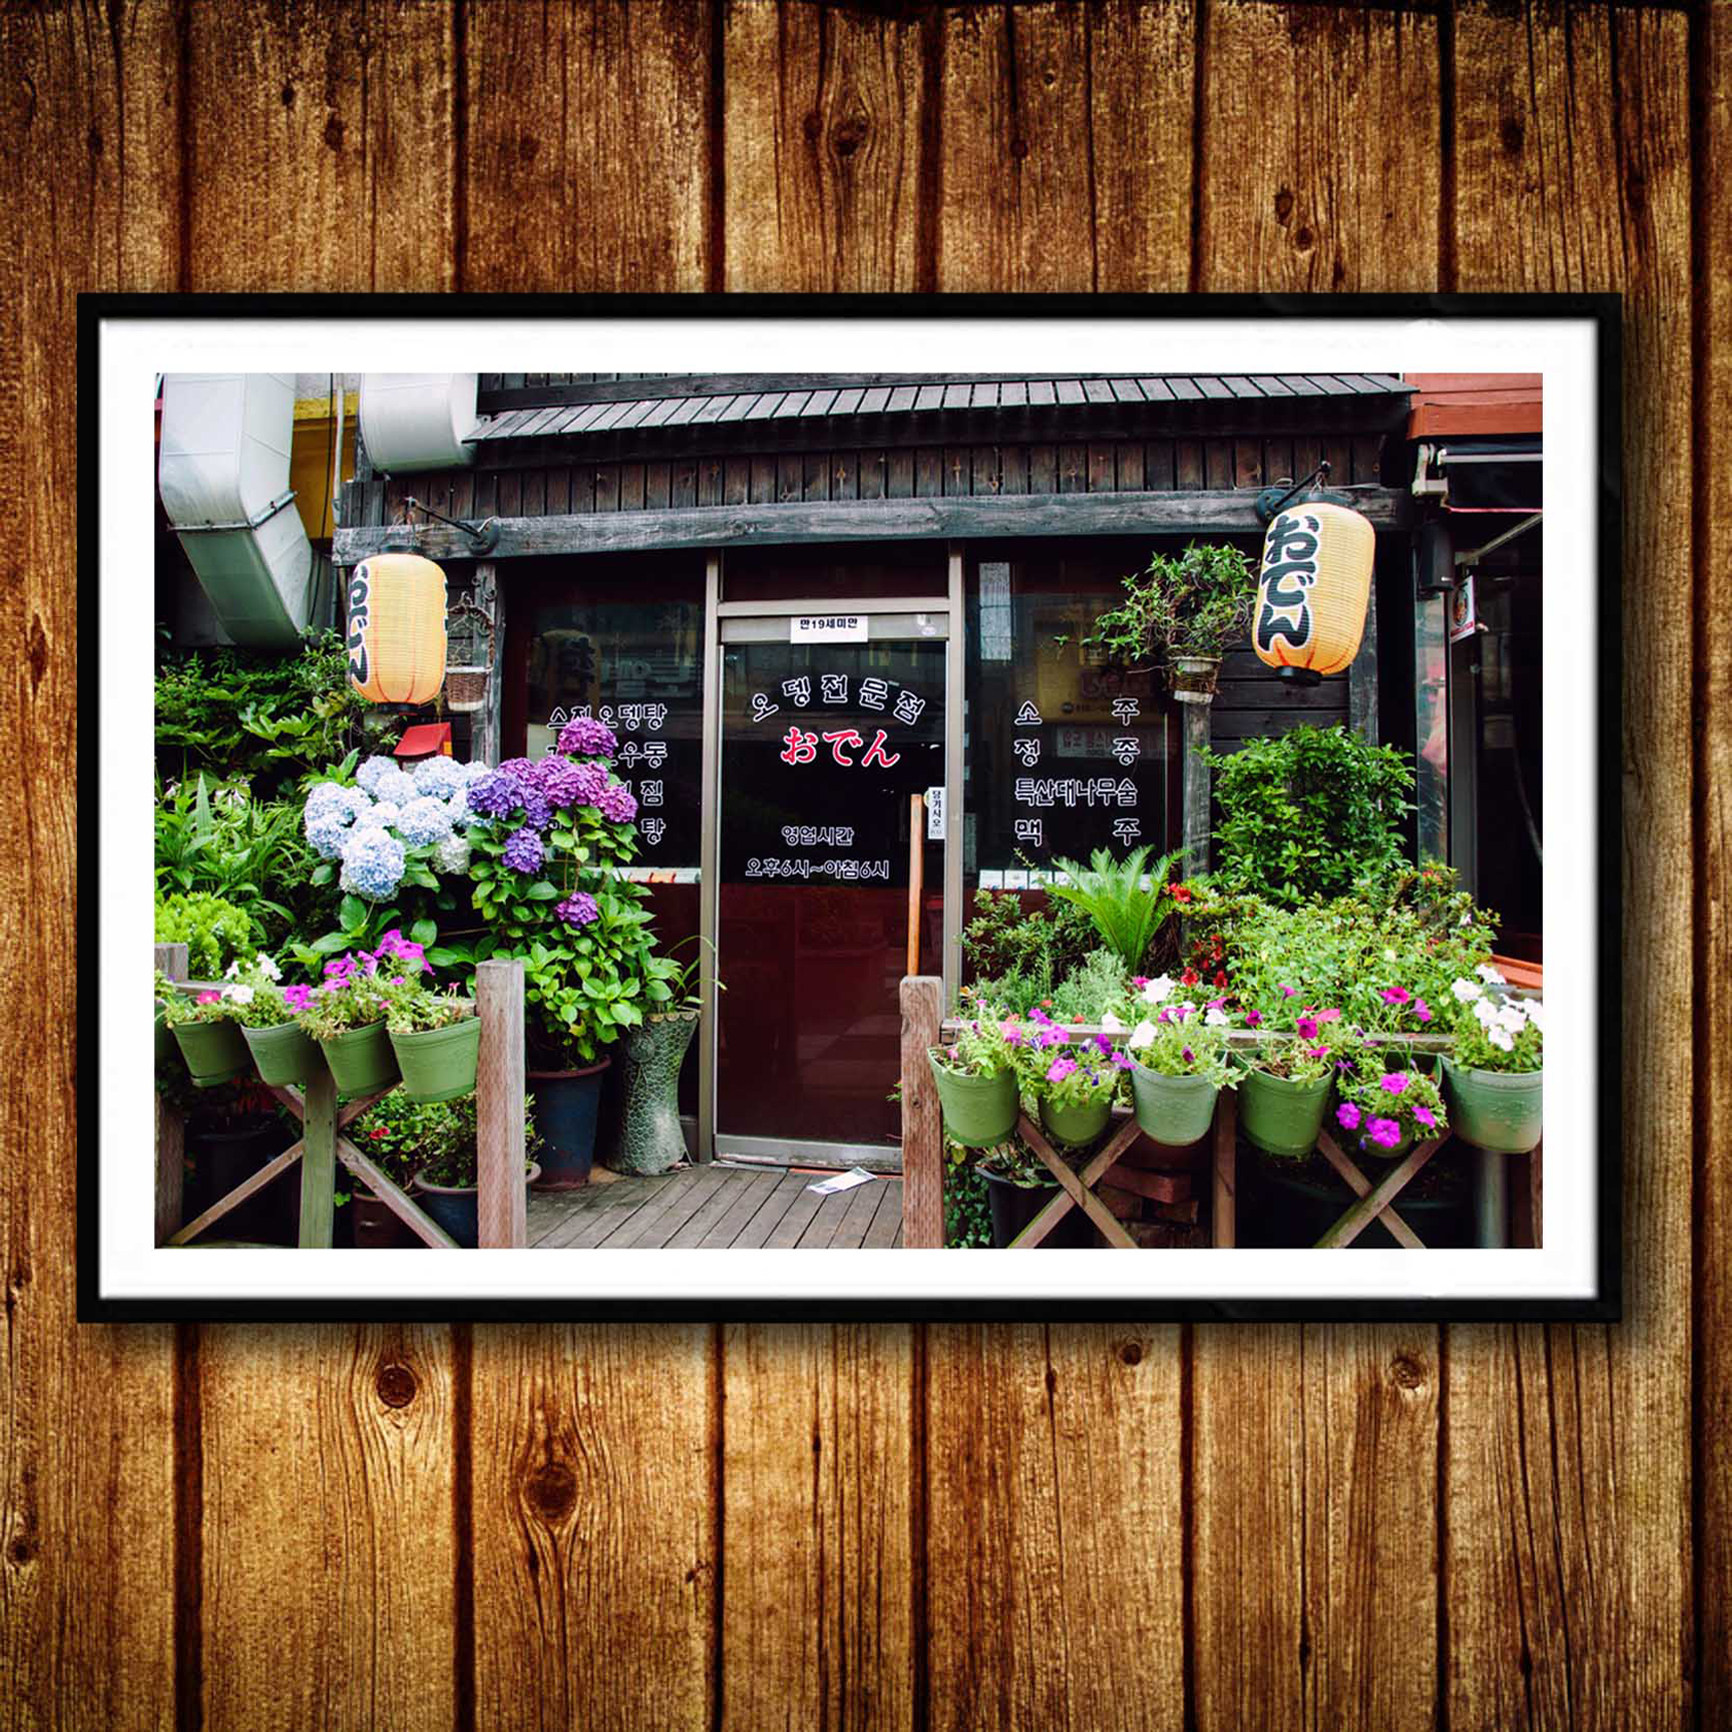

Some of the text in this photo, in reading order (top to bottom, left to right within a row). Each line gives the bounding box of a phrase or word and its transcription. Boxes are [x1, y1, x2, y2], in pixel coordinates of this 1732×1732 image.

[1256, 514, 1320, 652] おでん
[780, 726, 900, 768] おでん
[1014, 777, 1138, 807] 특산대나무술
[781, 825, 855, 846] 영업시간
